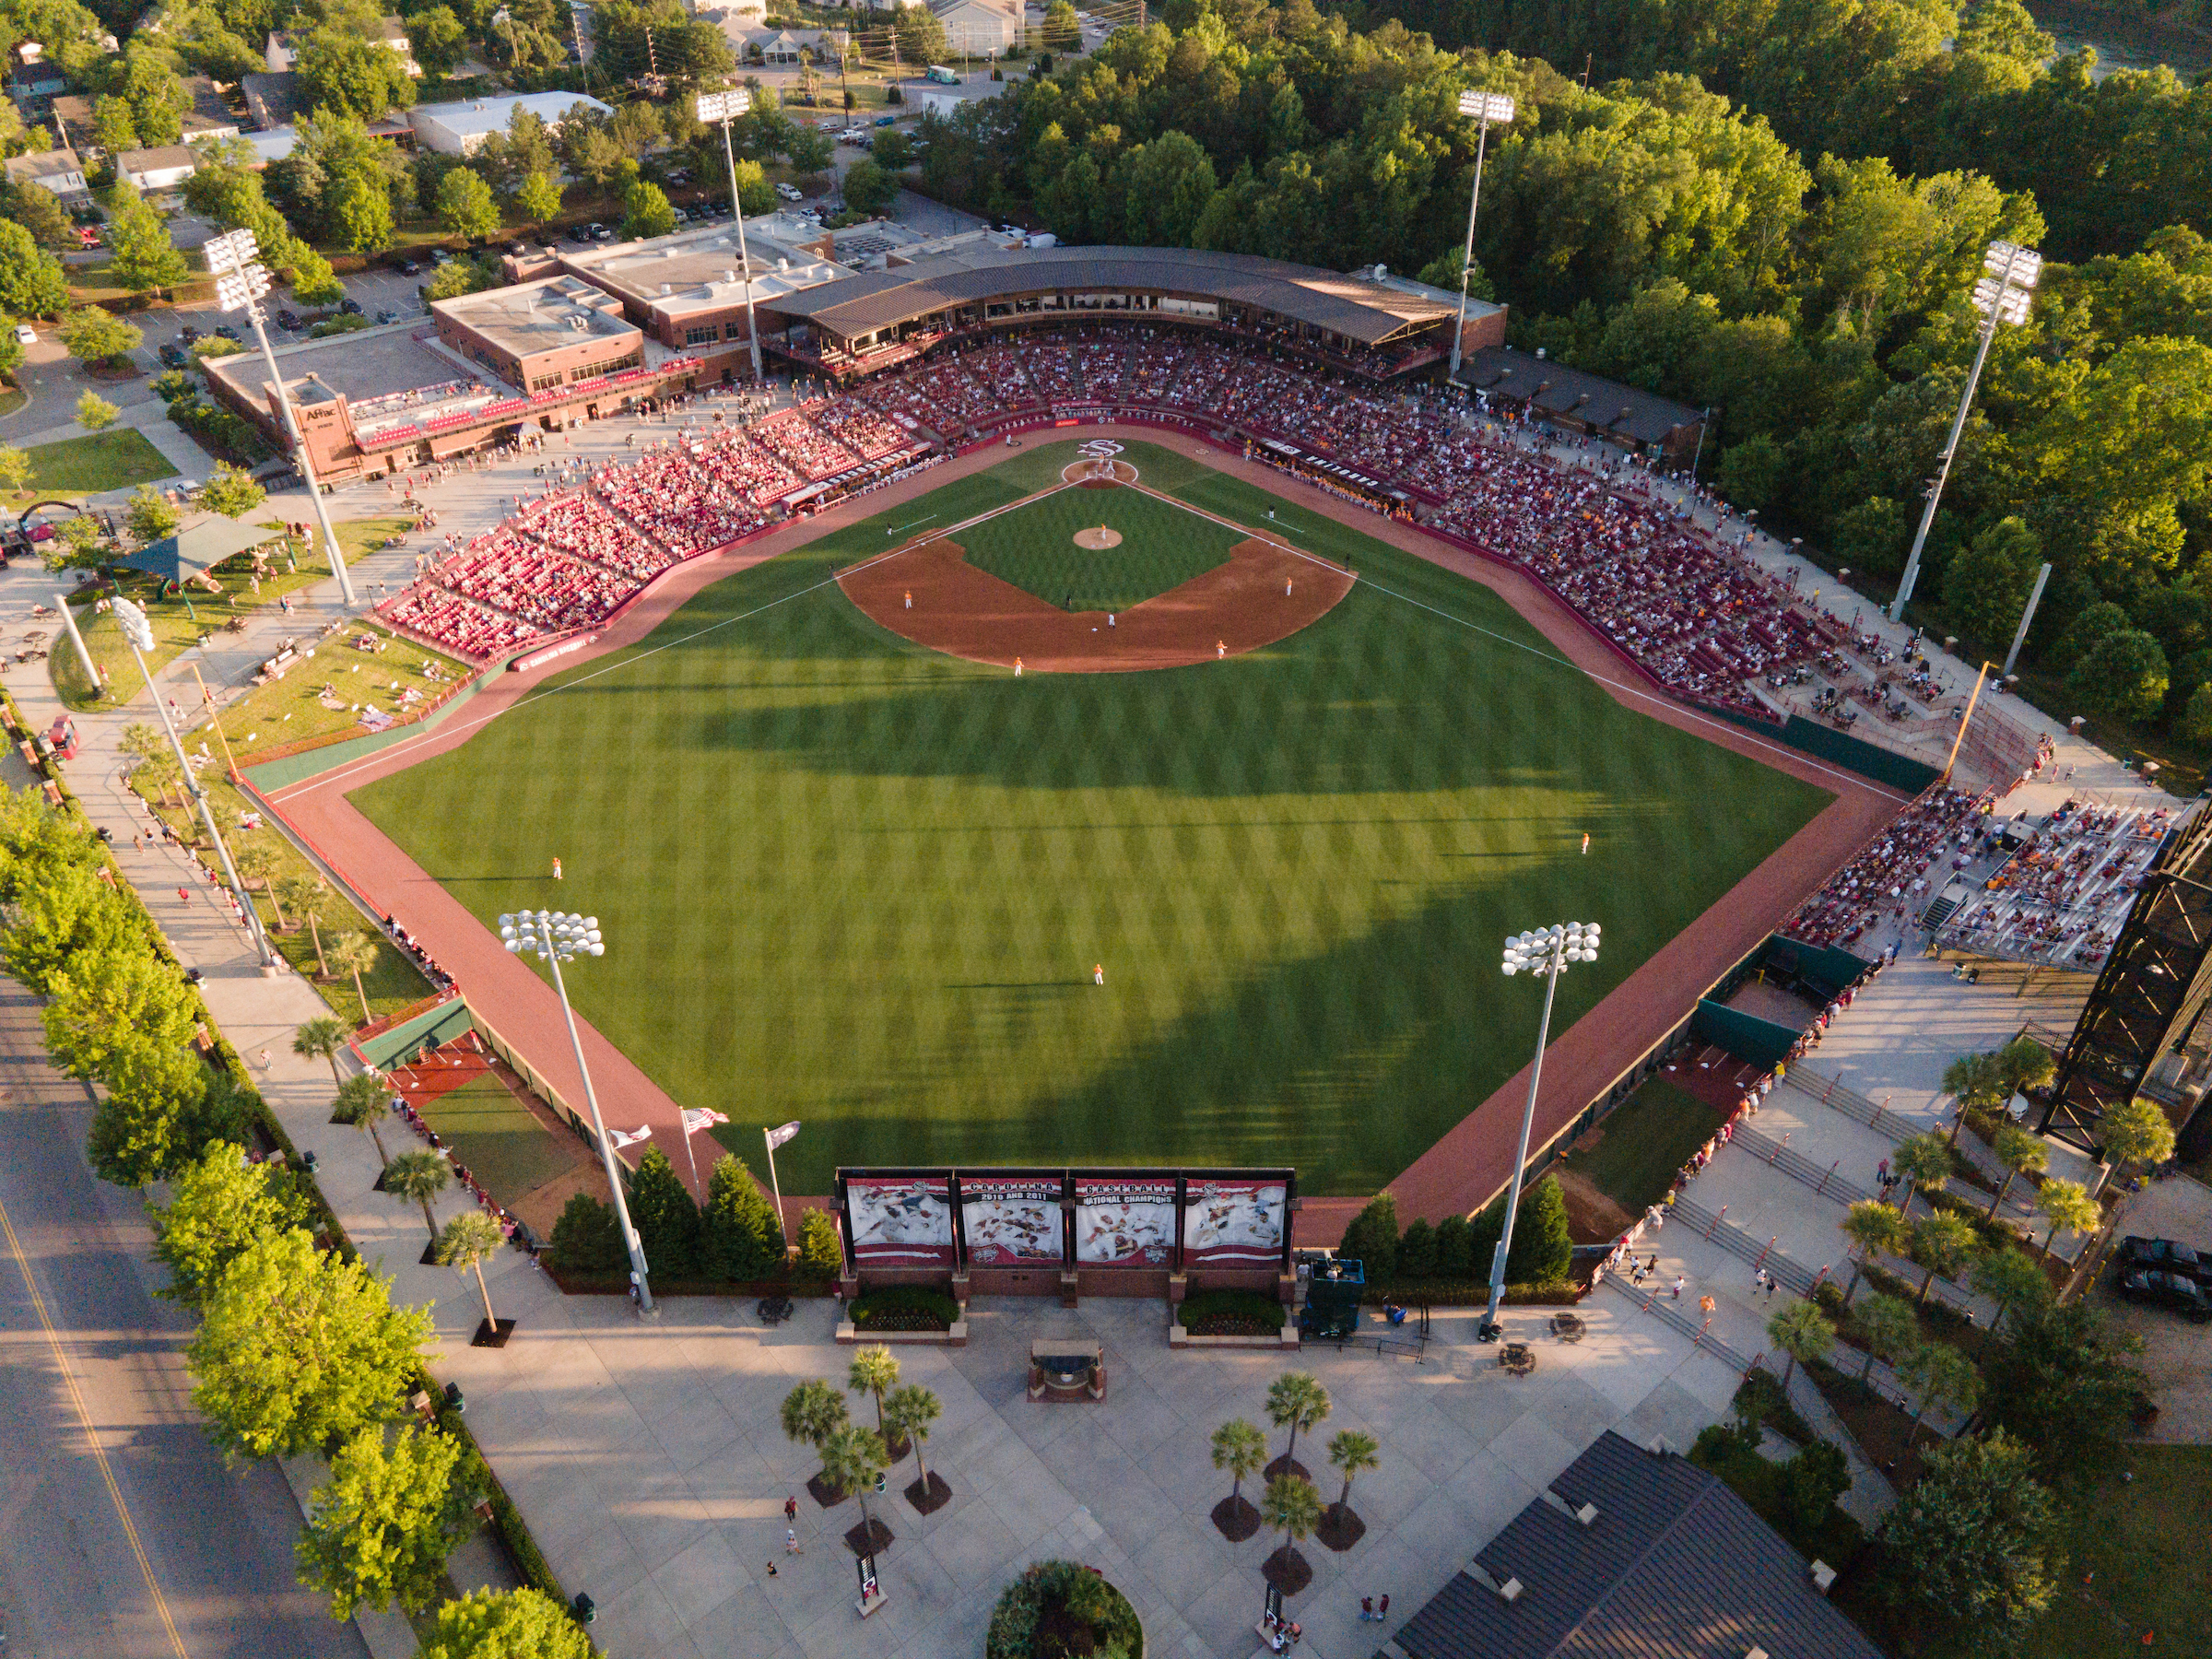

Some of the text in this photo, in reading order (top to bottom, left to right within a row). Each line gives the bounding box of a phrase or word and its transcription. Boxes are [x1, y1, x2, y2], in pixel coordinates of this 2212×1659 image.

[307, 408, 336, 421] Aflac
[1306, 455, 1379, 487] CAROLINA
[529, 650, 559, 667] CAROLINA
[559, 640, 588, 655] BASEBALL
[971, 1182, 1054, 1192] CAROLINA
[1087, 1184, 1169, 1194] BASEBALL
[982, 1192, 1047, 1201] 2010 AND 2011
[1083, 1194, 1171, 1206] NATIONAL CHAMPIONS
